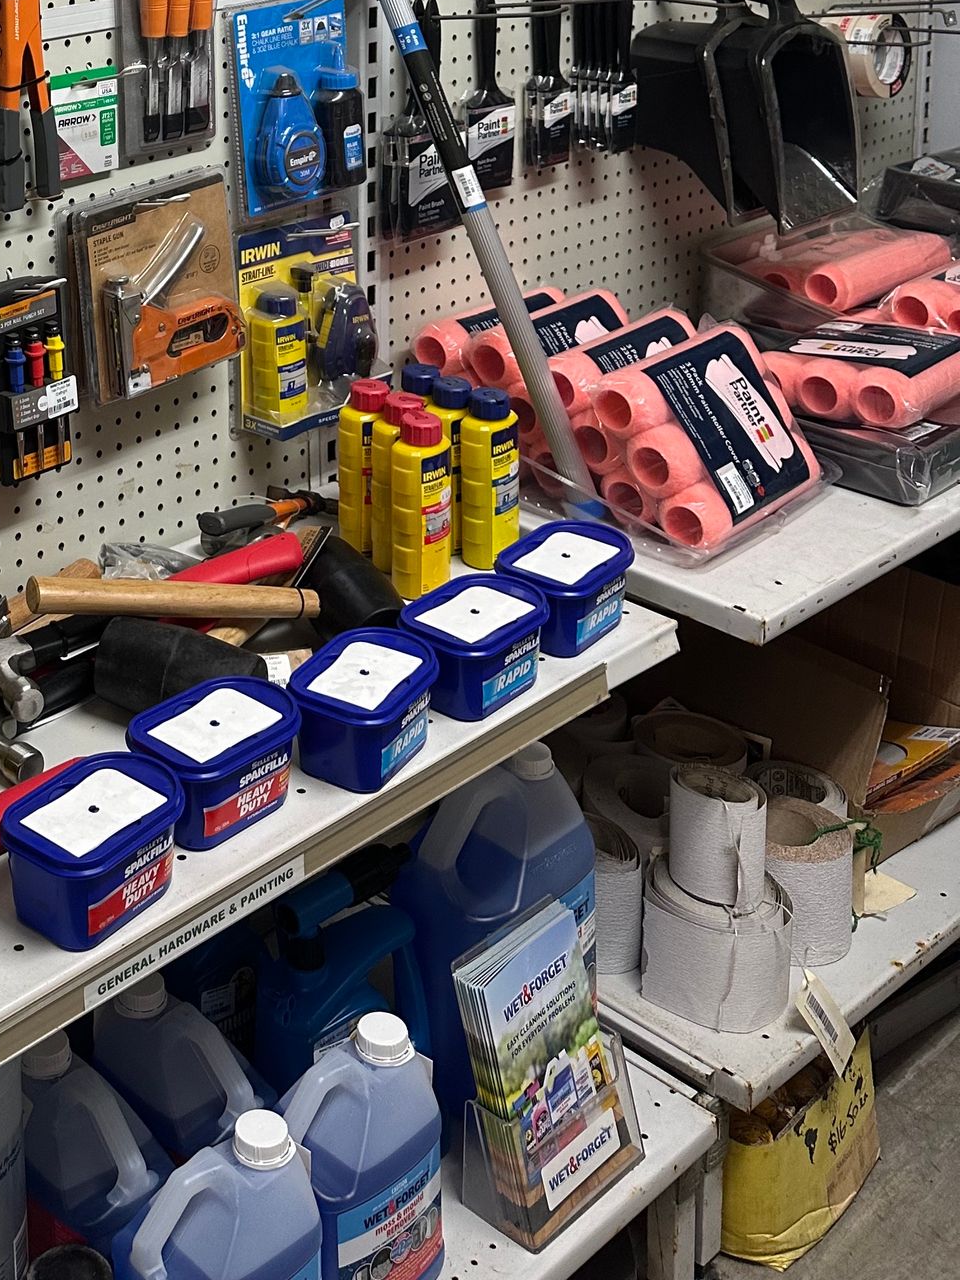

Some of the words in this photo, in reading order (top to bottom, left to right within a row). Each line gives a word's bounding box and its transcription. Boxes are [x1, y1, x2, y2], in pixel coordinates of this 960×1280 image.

[251, 36, 268, 47] CHALK
[260, 28, 276, 38] GEAR
[276, 25, 294, 35] RATIO
[267, 42, 280, 52] BLUE
[549, 99, 564, 111] Paint
[549, 107, 564, 115] Partner
[58, 116, 91, 128] ARROW
[477, 119, 501, 133] Paint
[477, 130, 501, 141] Partner
[93, 235, 112, 247] STAPLE
[240, 241, 281, 265] IRWIN
[276, 332, 297, 345] IRWIN
[689, 366, 704, 387] Pack
[678, 364, 700, 395] 230mm
[697, 394, 712, 415] Paint
[711, 414, 728, 440] Roller
[724, 439, 741, 464] Cover
[729, 381, 758, 427] Partner
[736, 376, 766, 425] Paint
[492, 438, 515, 456] IRWIN
[422, 466, 446, 482] IRWIN
[589, 600, 619, 629] RAPID
[504, 636, 540, 667] SPAKFILLA
[496, 662, 532, 692] RAPID
[393, 718, 425, 759] RAPID
[239, 752, 289, 789] SPAKFILLA
[236, 777, 275, 808] HEAVY
[240, 791, 270, 818] DUTY
[124, 835, 173, 880] SPAKFILLA
[121, 864, 161, 900] HEAVY
[124, 877, 157, 910] DUTY
[96, 954, 156, 996] GENERAL
[158, 909, 226, 960] HARDWARE
[228, 903, 237, 915] &
[240, 867, 295, 906] PAINTING
[503, 952, 568, 1023] WET&FORGET
[506, 1034, 520, 1052] EASY
[520, 1007, 546, 1038] CLEANING
[546, 980, 577, 1011] SOLUTIONS
[510, 1043, 523, 1060] FOR
[522, 1019, 548, 1050] EVERYDAY
[548, 993, 576, 1022] PROBLEMS
[548, 1125, 613, 1192] WET&FORGET
[374, 1217, 396, 1237] moss
[403, 1191, 424, 1216] mould
